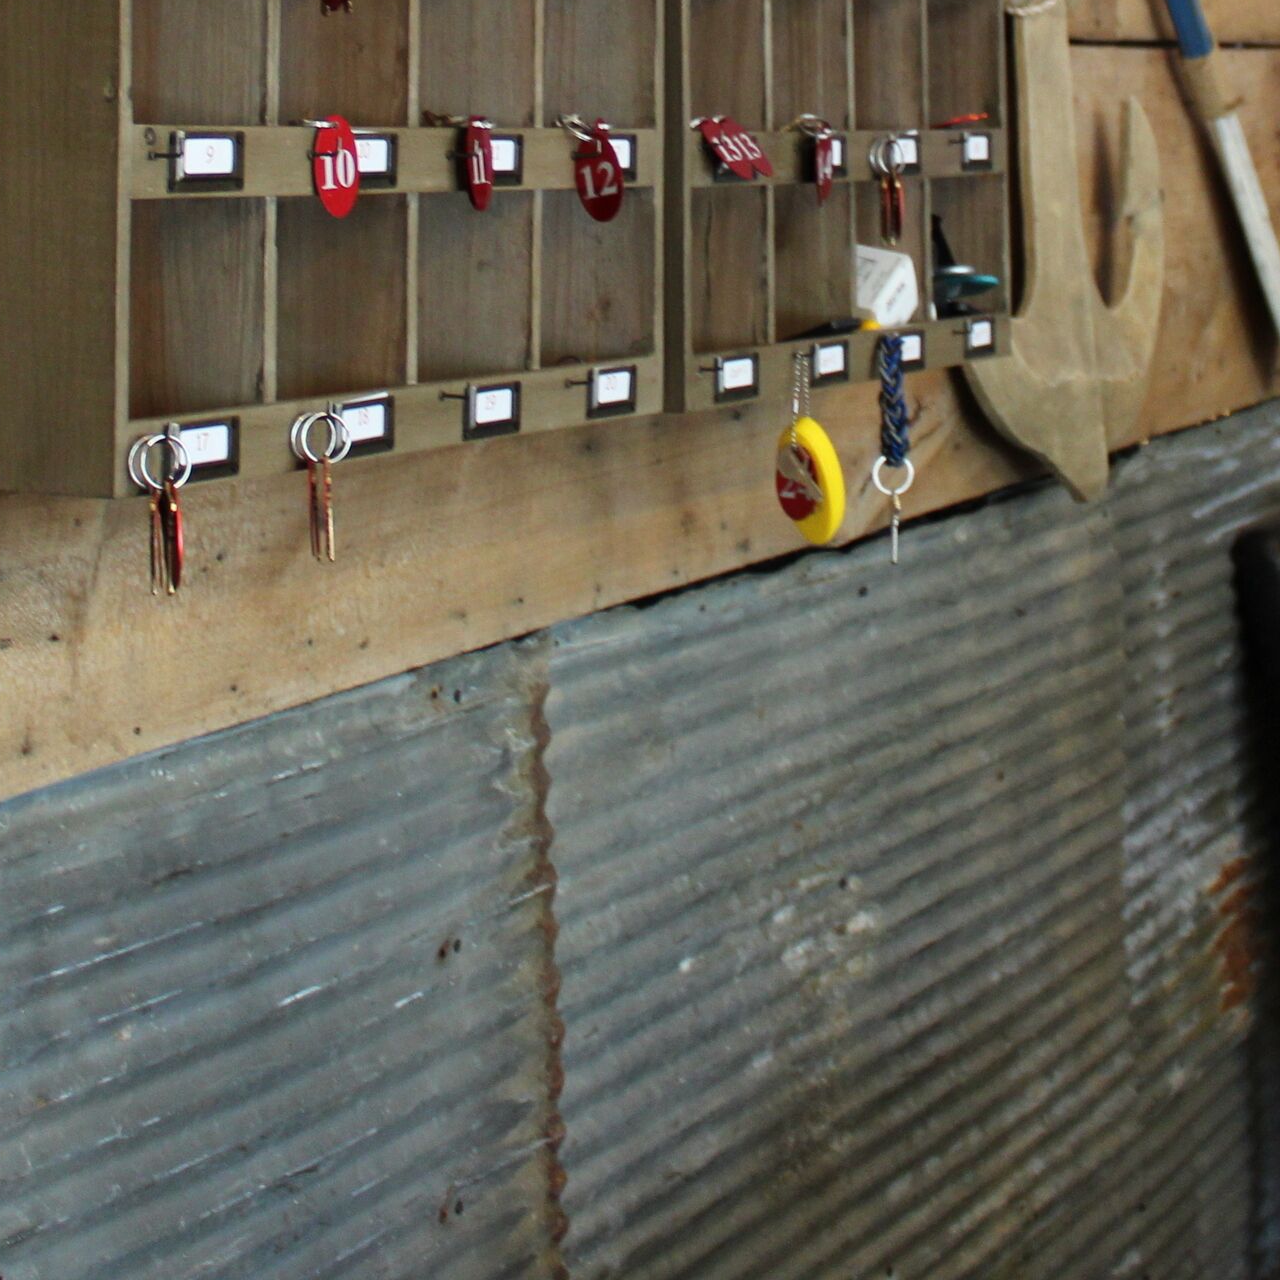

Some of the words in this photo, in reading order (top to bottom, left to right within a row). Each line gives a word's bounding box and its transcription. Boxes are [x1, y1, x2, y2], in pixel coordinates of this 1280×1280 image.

[472, 146, 489, 185] 11
[712, 136, 742, 162] 13
[739, 133, 763, 159] 13
[320, 149, 356, 190] 10
[580, 160, 619, 200] 12
